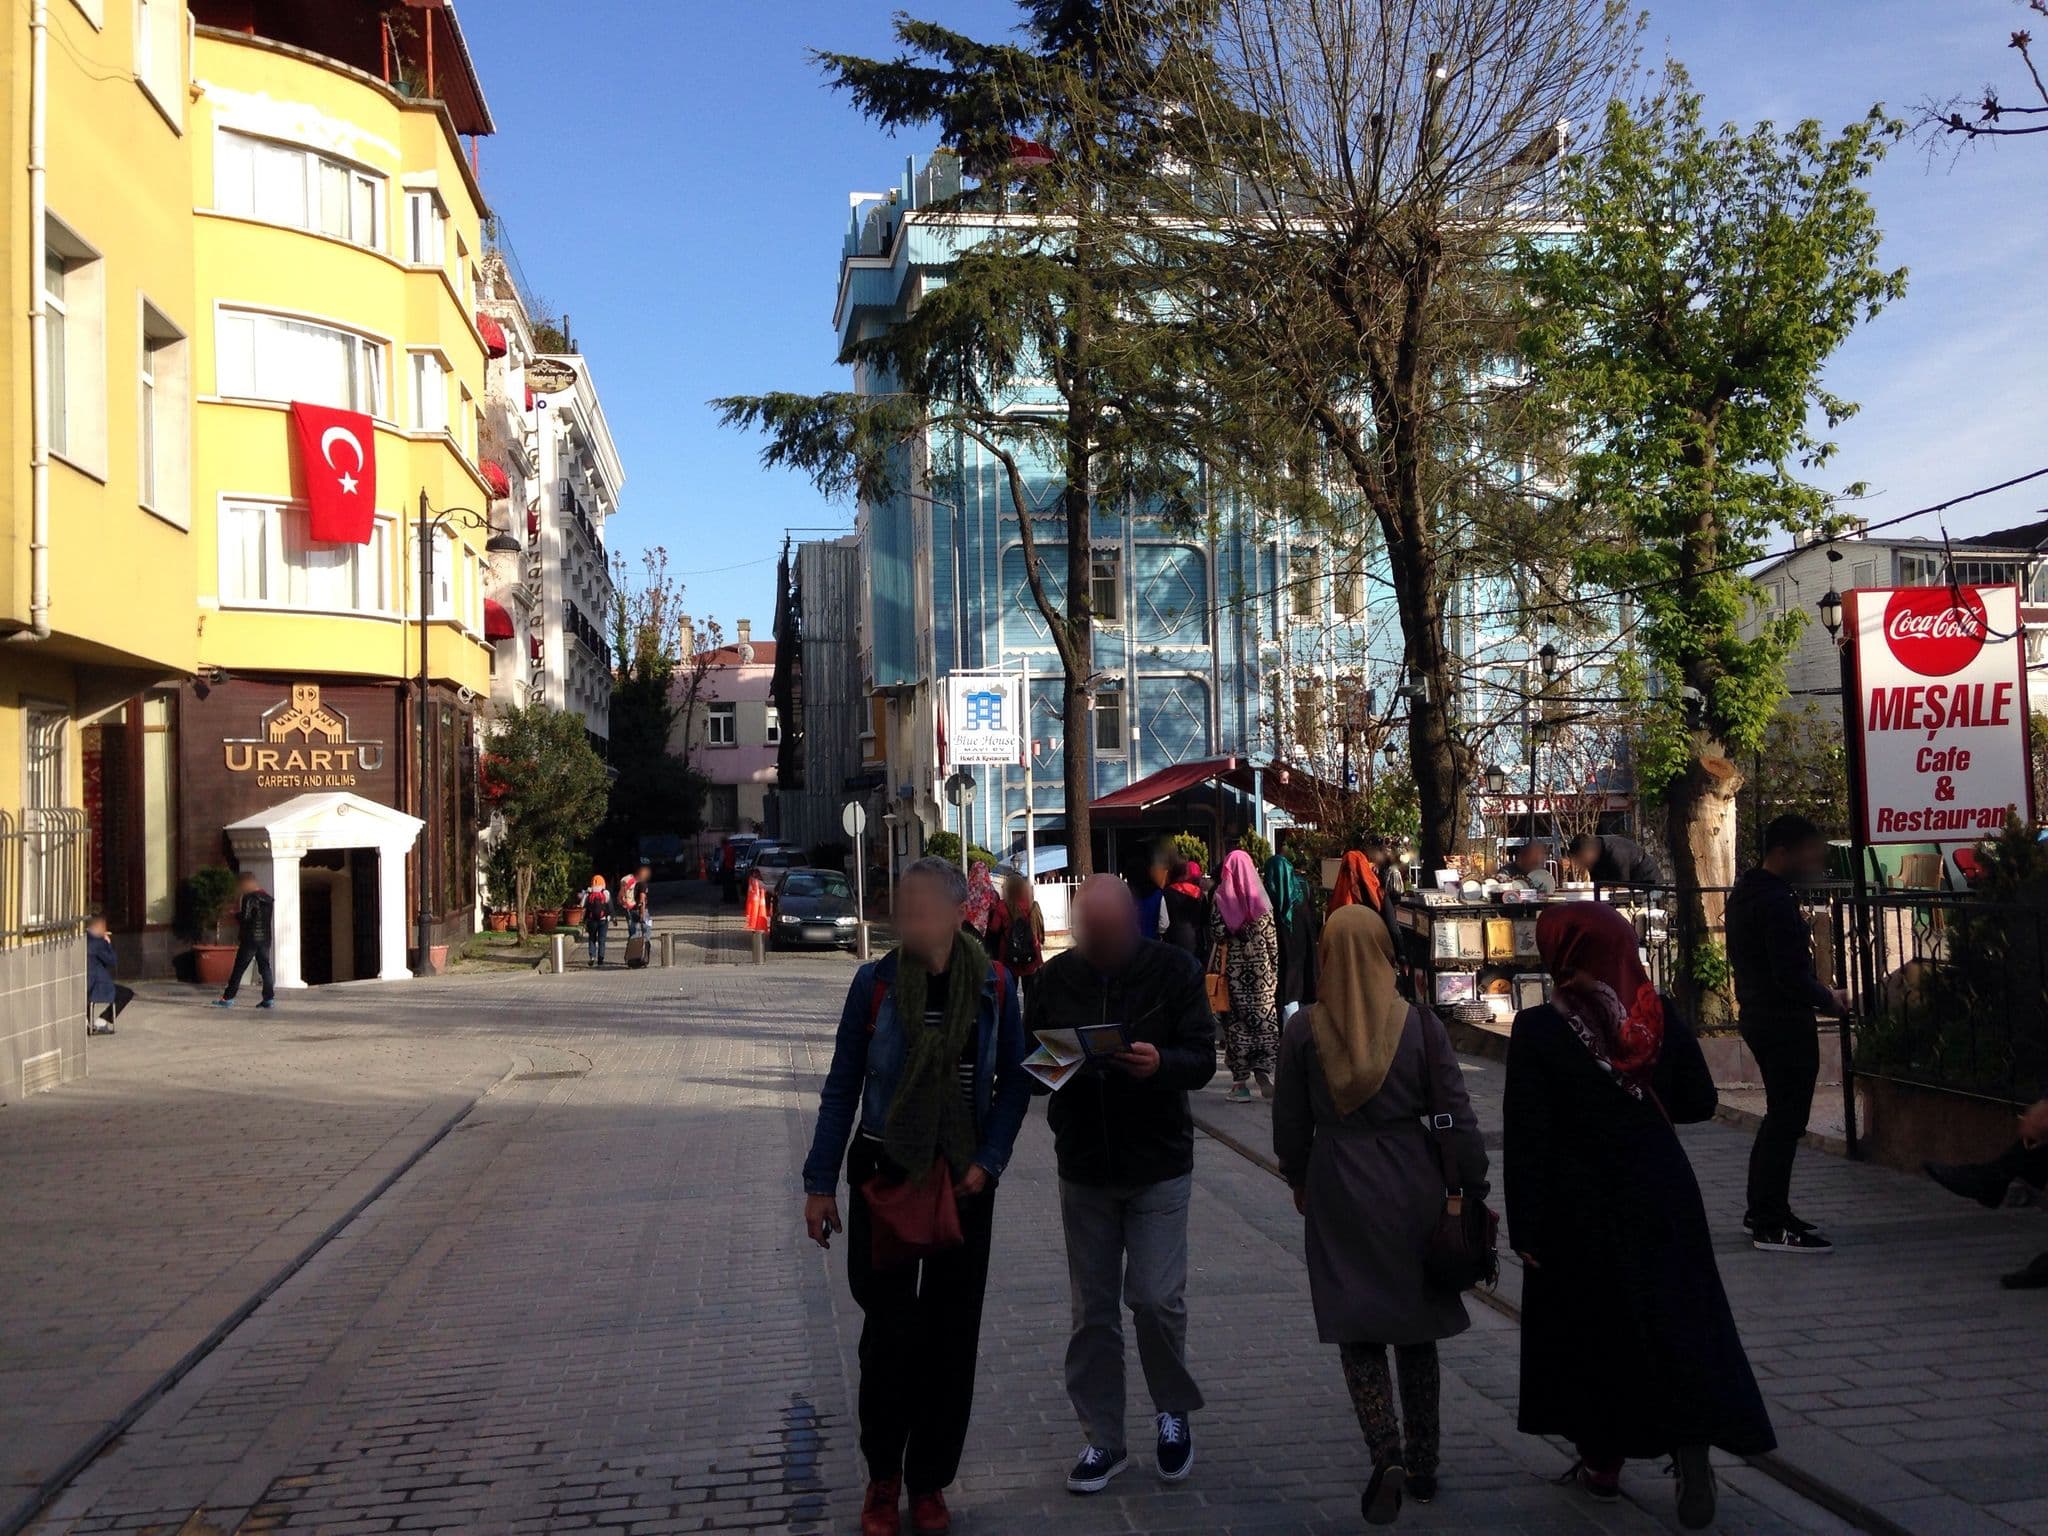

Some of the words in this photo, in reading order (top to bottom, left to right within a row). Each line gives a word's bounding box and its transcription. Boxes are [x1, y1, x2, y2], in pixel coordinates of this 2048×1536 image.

[1889, 606, 1983, 641] Coca-Cola
[1868, 682, 2013, 741] MEŞALE
[953, 734, 979, 746] Blue
[981, 734, 1016, 746] House
[224, 745, 384, 772] URARTU
[1916, 746, 1971, 773] Cafe
[257, 775, 301, 788] CARPETS
[303, 775, 322, 787] AND
[325, 774, 356, 787] KILIMS
[1935, 775, 1955, 801] &
[1877, 803, 2016, 833] Restauran
